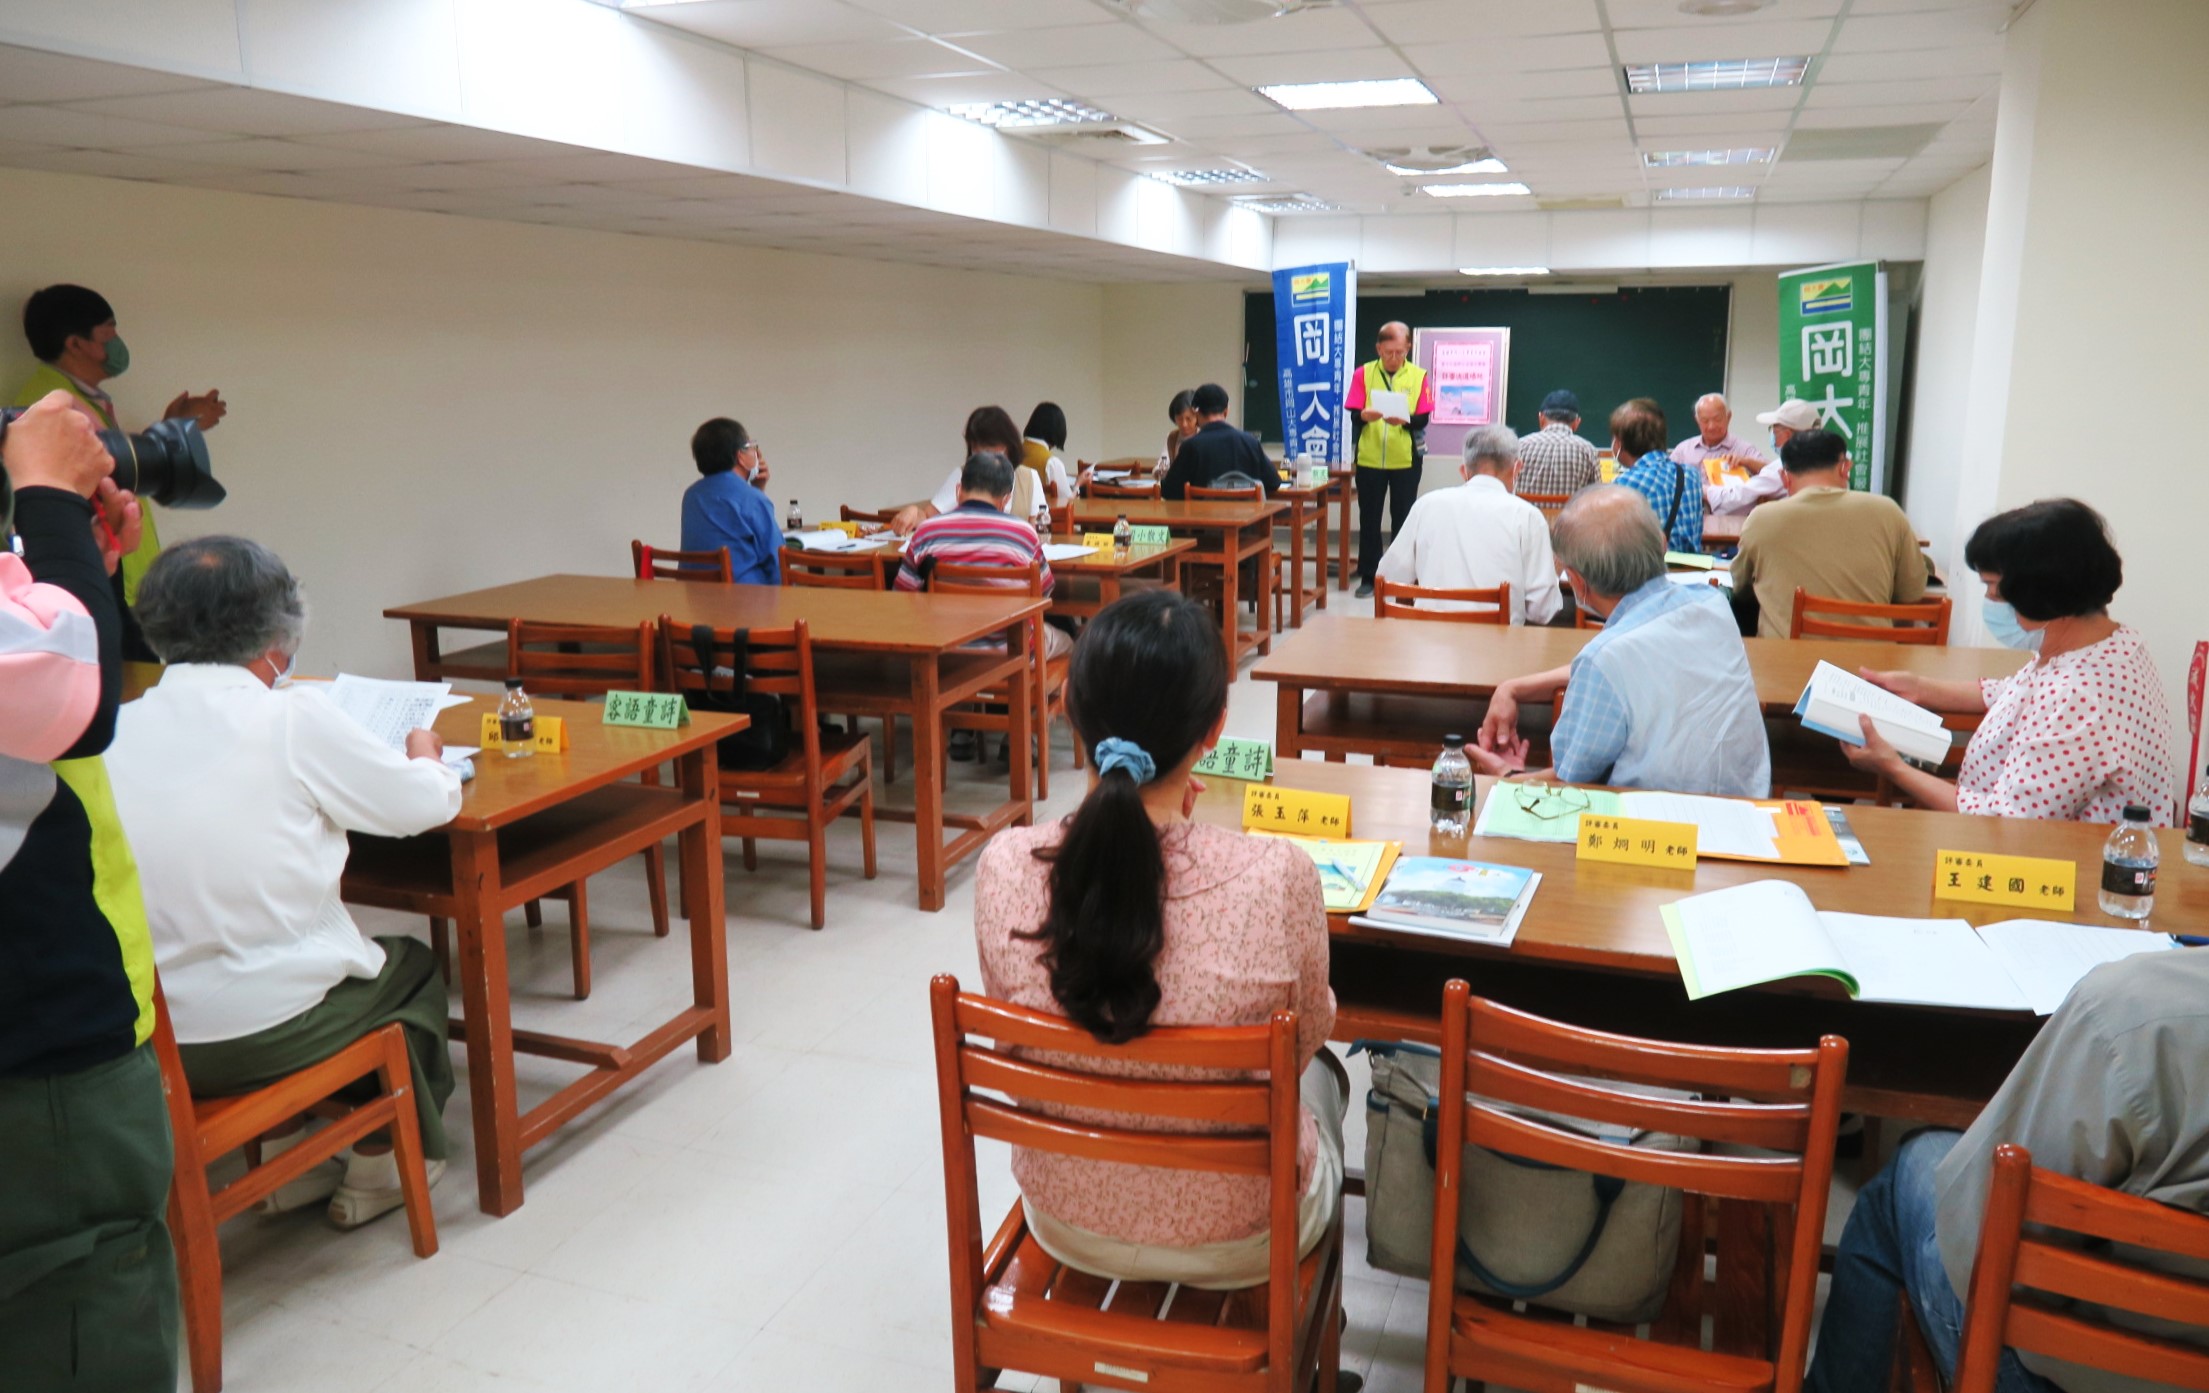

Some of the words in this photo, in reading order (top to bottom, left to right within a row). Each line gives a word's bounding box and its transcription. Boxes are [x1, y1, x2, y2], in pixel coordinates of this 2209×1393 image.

[607, 692, 678, 725] 客語童詩
[1321, 815, 1340, 827] 老師
[1665, 844, 1688, 857] 老師
[2040, 884, 2065, 898] 老師
